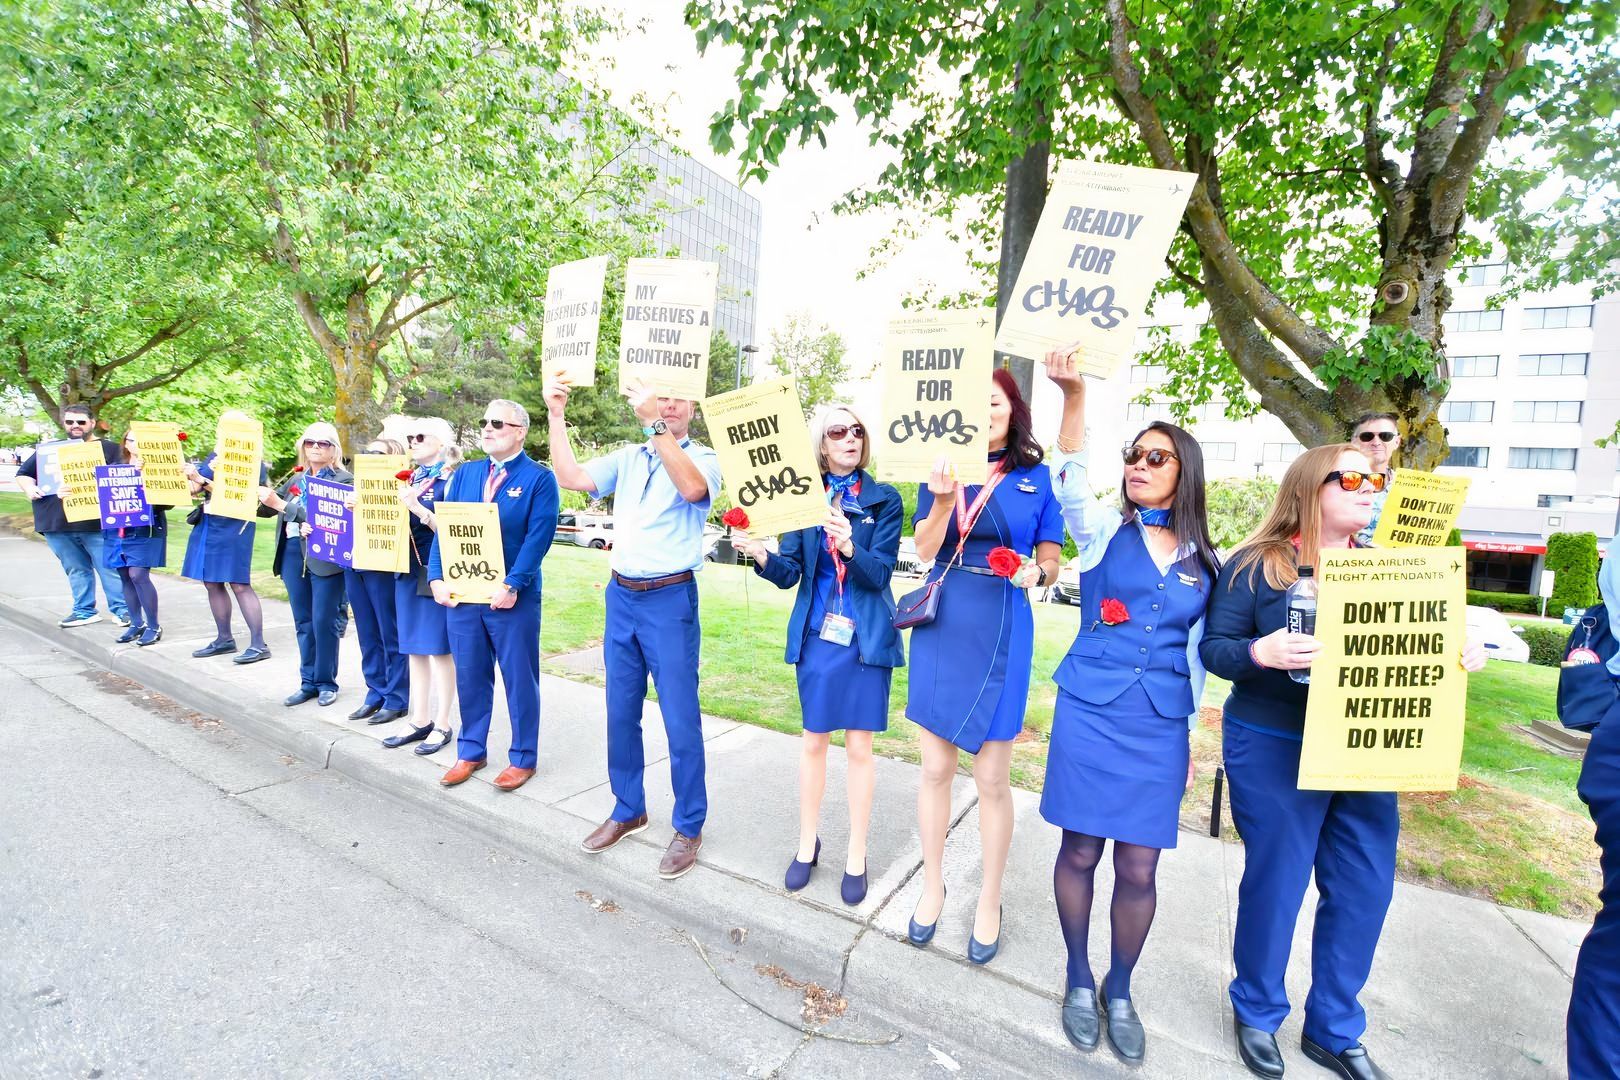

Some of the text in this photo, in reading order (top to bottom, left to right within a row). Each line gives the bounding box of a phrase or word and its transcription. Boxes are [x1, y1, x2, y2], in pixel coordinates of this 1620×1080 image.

[1062, 206, 1144, 240] READY
[1068, 244, 1116, 275] FOR
[635, 285, 658, 300] MY
[546, 301, 598, 323] DESERVES A
[1022, 278, 1129, 330] CHAOS
[626, 306, 710, 326] DESERVES A
[556, 323, 577, 338] NEW
[648, 328, 682, 345] NEW
[544, 342, 590, 362] CONTRACT
[626, 348, 702, 369] CONTRACT
[902, 348, 965, 371] READY
[916, 380, 952, 402] FOR
[726, 414, 780, 445] READY
[888, 409, 978, 446] CHAOS
[142, 454, 178, 464] STALLING
[224, 452, 252, 463] WORKING
[748, 444, 782, 468] FOR
[64, 472, 96, 483] STALLIN
[159, 468, 171, 476] PAY
[146, 480, 186, 490] APPALLING
[225, 478, 248, 488] NEITHER
[360, 479, 399, 490] DON'T LIKE
[738, 466, 812, 507] CHAOS
[111, 486, 138, 499] SAVE
[308, 482, 350, 502] CORPORAT
[362, 494, 398, 506] WORKING
[109, 499, 142, 512] LIVES!
[318, 500, 343, 516] GREED
[1400, 497, 1456, 514] DON'T LIKE
[314, 514, 348, 533] DOESN'T
[362, 509, 400, 521] FOR FREE?
[1396, 513, 1448, 530] WORKING
[366, 524, 396, 536] NEITHER
[449, 524, 484, 538] READY
[1390, 529, 1442, 546] FOR FREE?
[324, 532, 338, 546] FLY
[368, 540, 395, 550] DO WE!
[460, 543, 481, 556] FOR
[448, 560, 499, 581] CHAOS
[1326, 558, 1427, 568] ALASKA AIRLINES
[1325, 572, 1444, 582] FLIGHT ATTENDANTS
[1343, 600, 1448, 624] DON'T LIKE
[1290, 610, 1299, 633] ntia
[1344, 633, 1444, 656] WORKING
[1338, 665, 1444, 688] FOR FREE?
[1344, 698, 1432, 718] NEITHER
[1346, 728, 1424, 749] DO WE!
